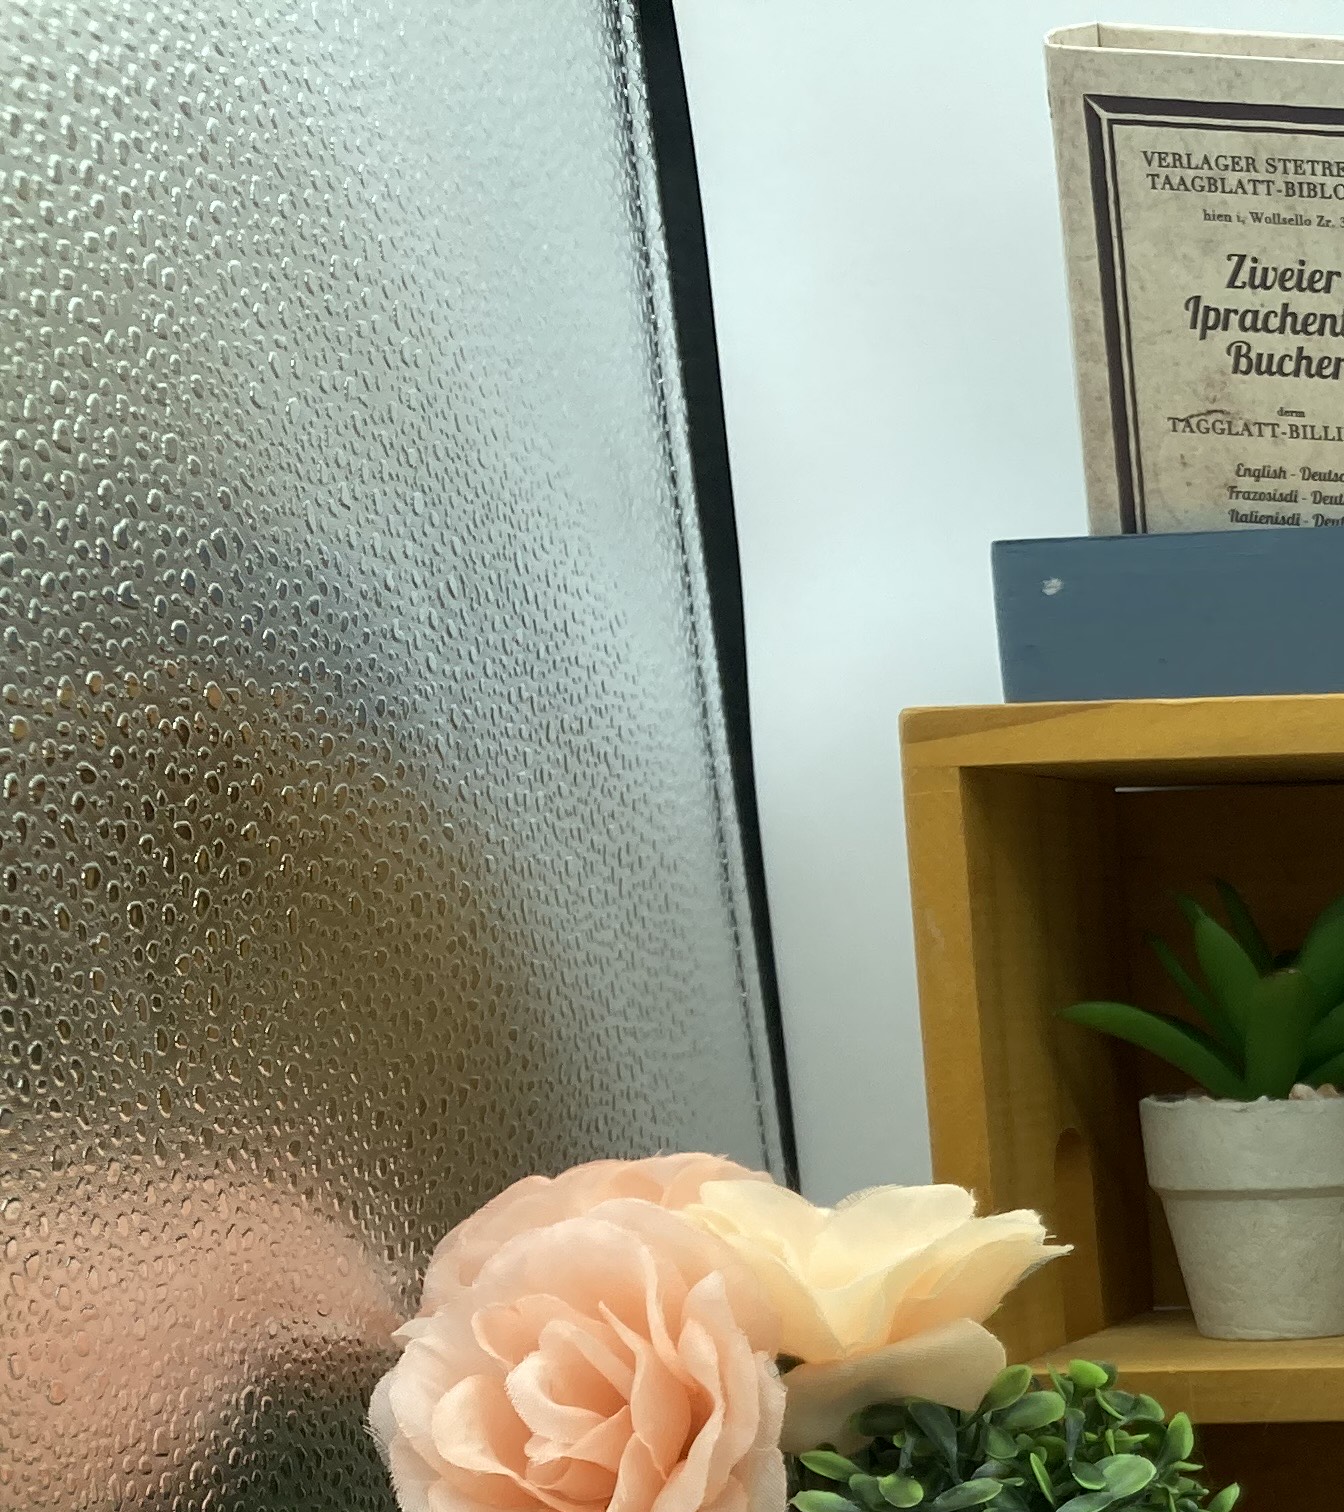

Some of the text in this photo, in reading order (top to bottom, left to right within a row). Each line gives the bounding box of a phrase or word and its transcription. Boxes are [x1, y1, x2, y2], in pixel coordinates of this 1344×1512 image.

[1140, 150, 1260, 173] VERLAGER
[1225, 253, 1342, 294] Ziweier
[1234, 463, 1287, 482] English
